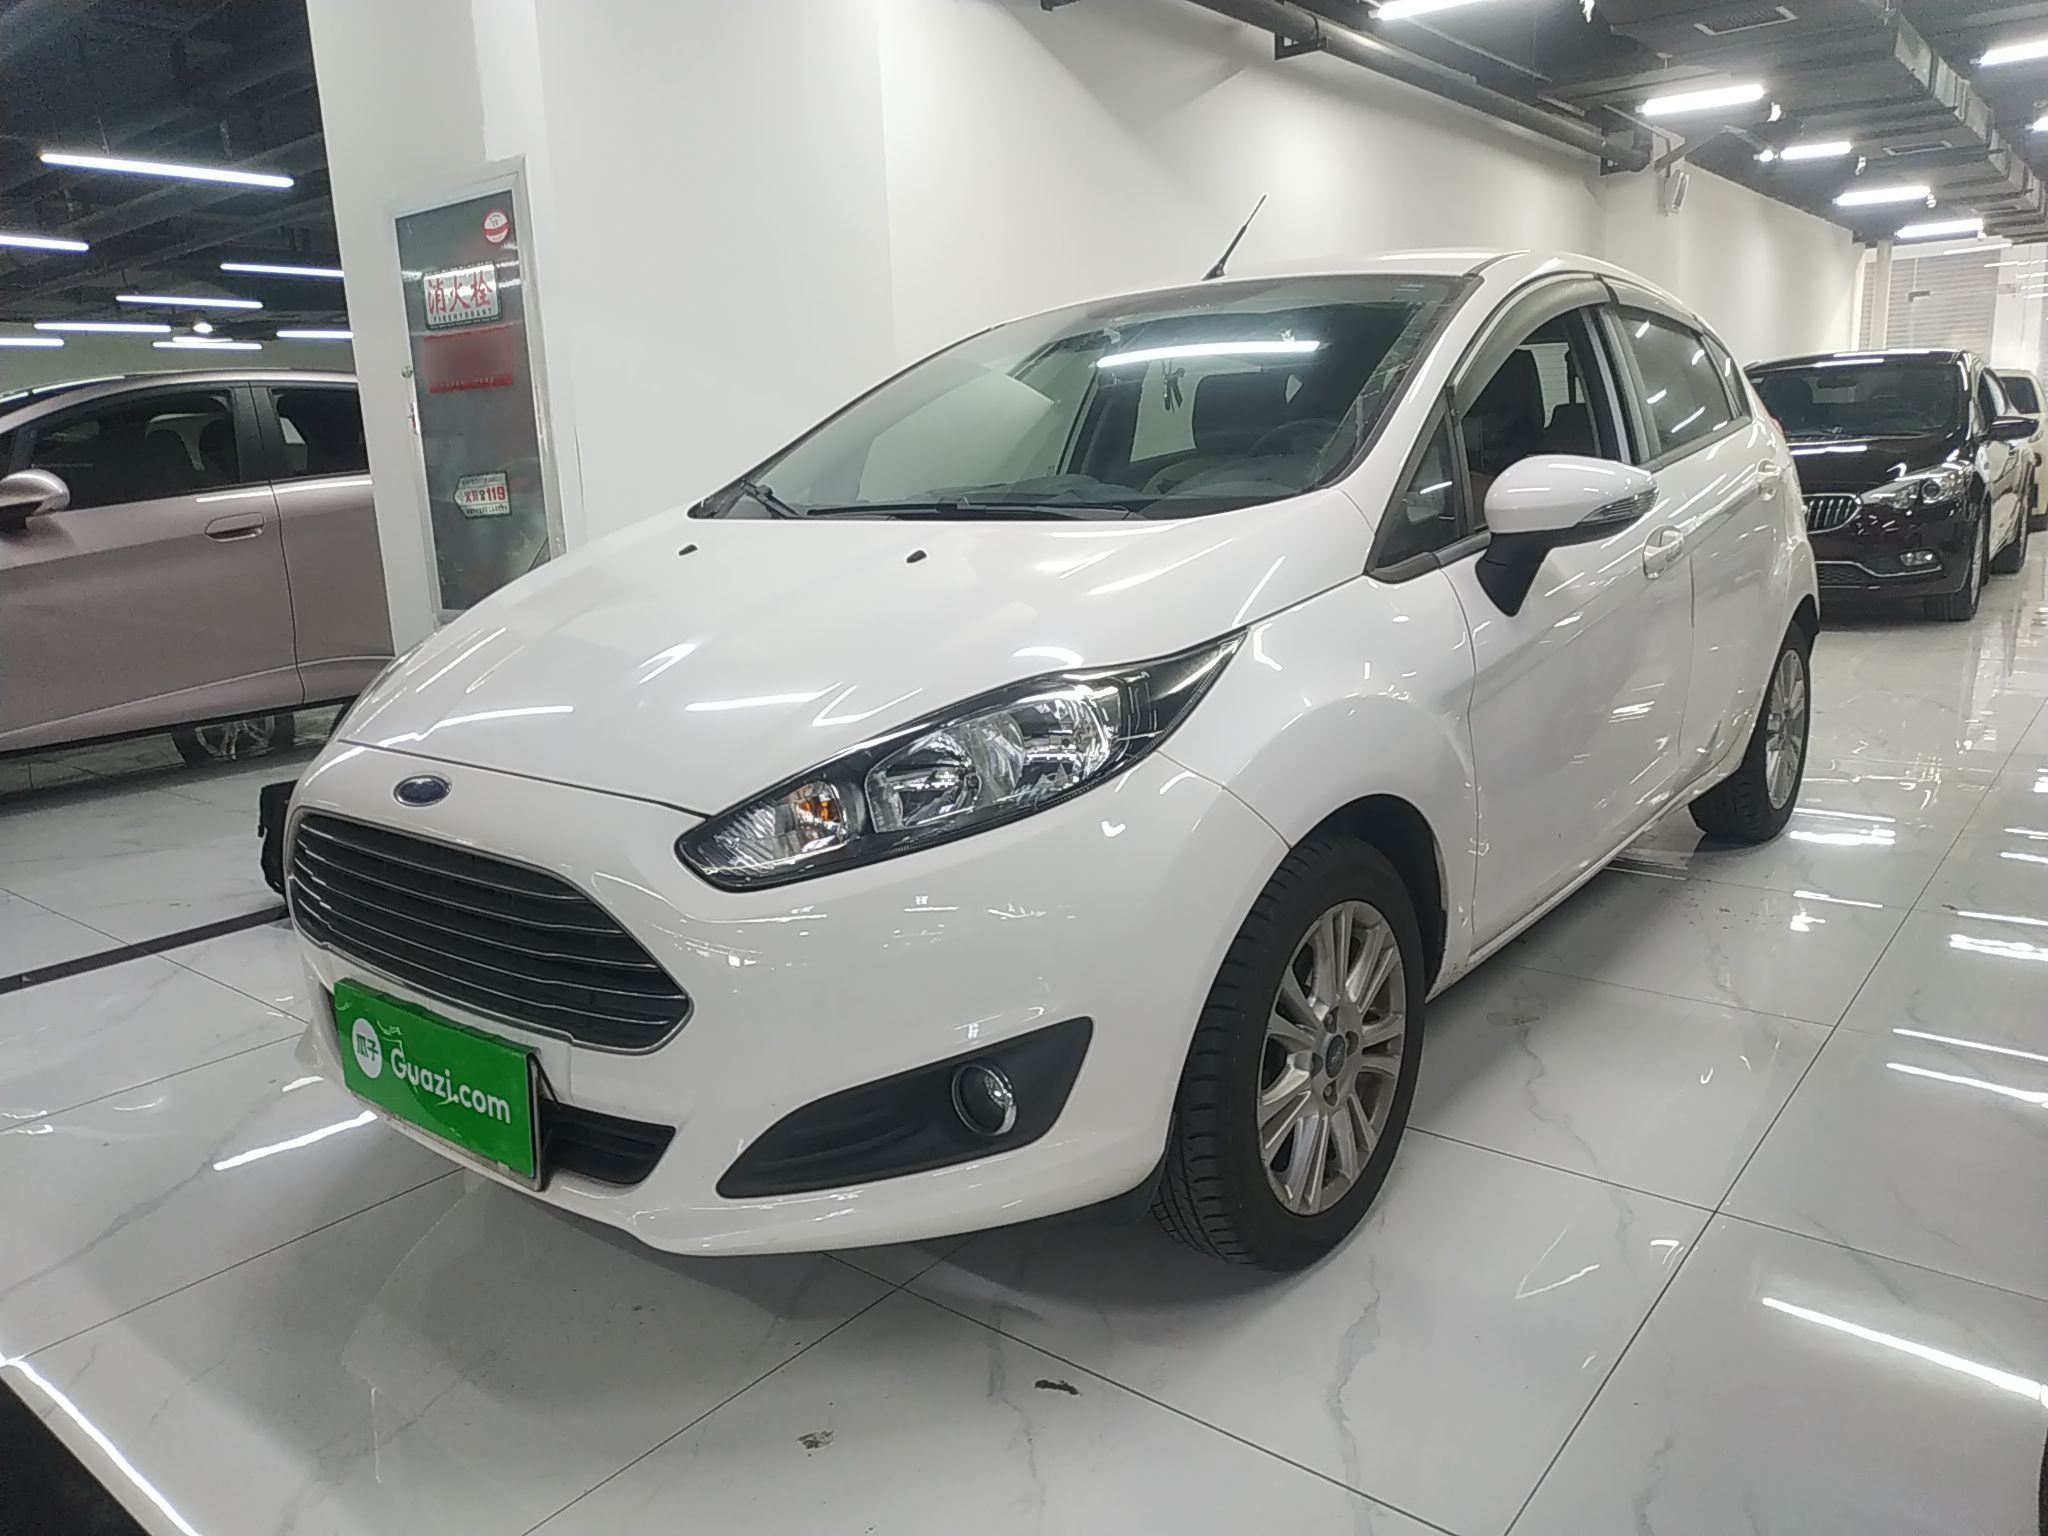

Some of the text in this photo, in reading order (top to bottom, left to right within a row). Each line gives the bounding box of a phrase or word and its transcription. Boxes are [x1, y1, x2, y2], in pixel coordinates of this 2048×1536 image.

[428, 270, 493, 314] 消火栓
[486, 486, 506, 501] 119
[357, 1034, 379, 1061] 瓜子
[391, 1048, 511, 1124] Guazi.com
